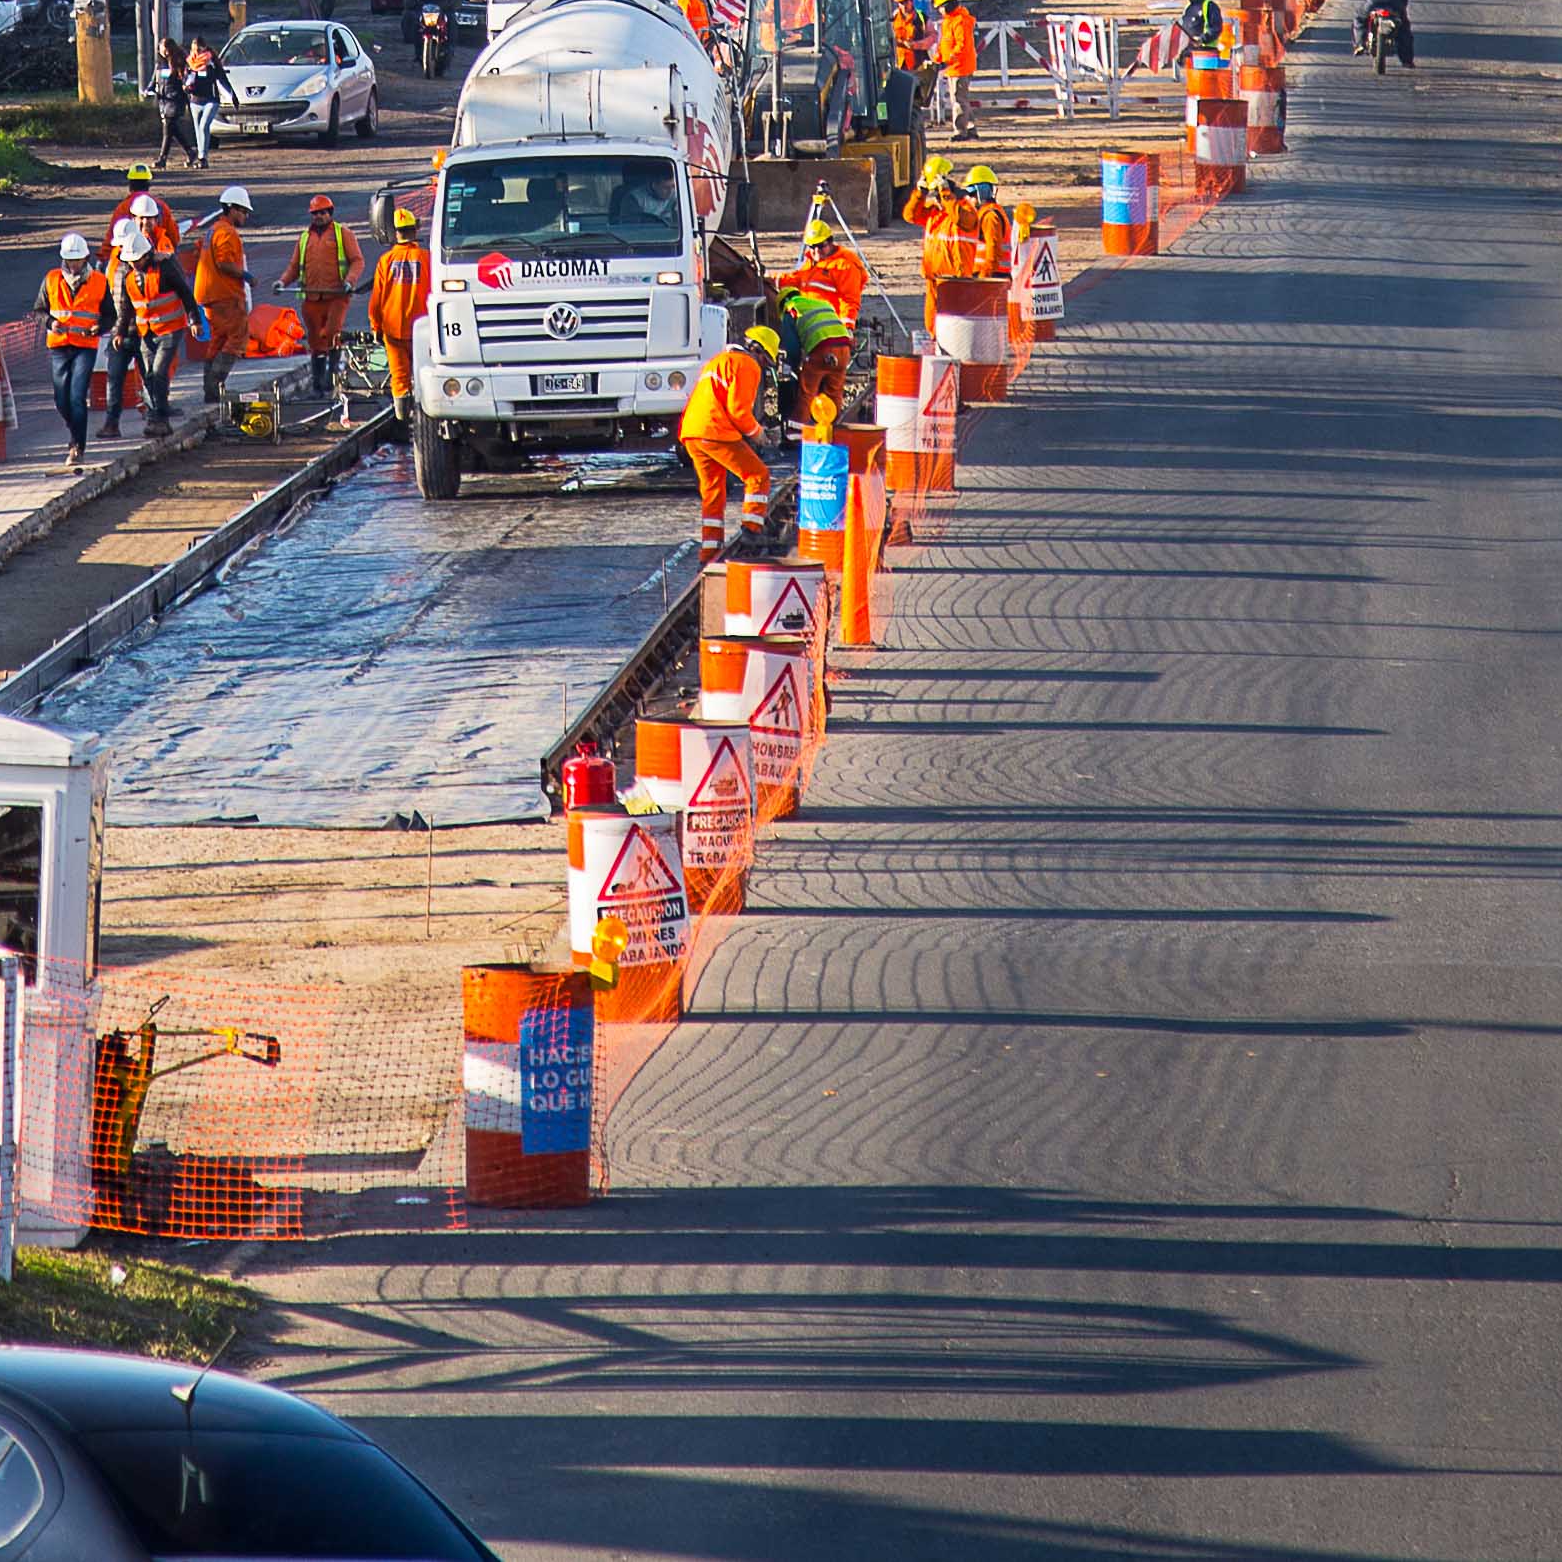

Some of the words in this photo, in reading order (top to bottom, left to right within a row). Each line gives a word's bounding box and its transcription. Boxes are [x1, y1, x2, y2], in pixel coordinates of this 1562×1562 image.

[520, 260, 611, 278] DACOMAT
[443, 322, 462, 337] 18
[529, 1093, 576, 1113] QUE
